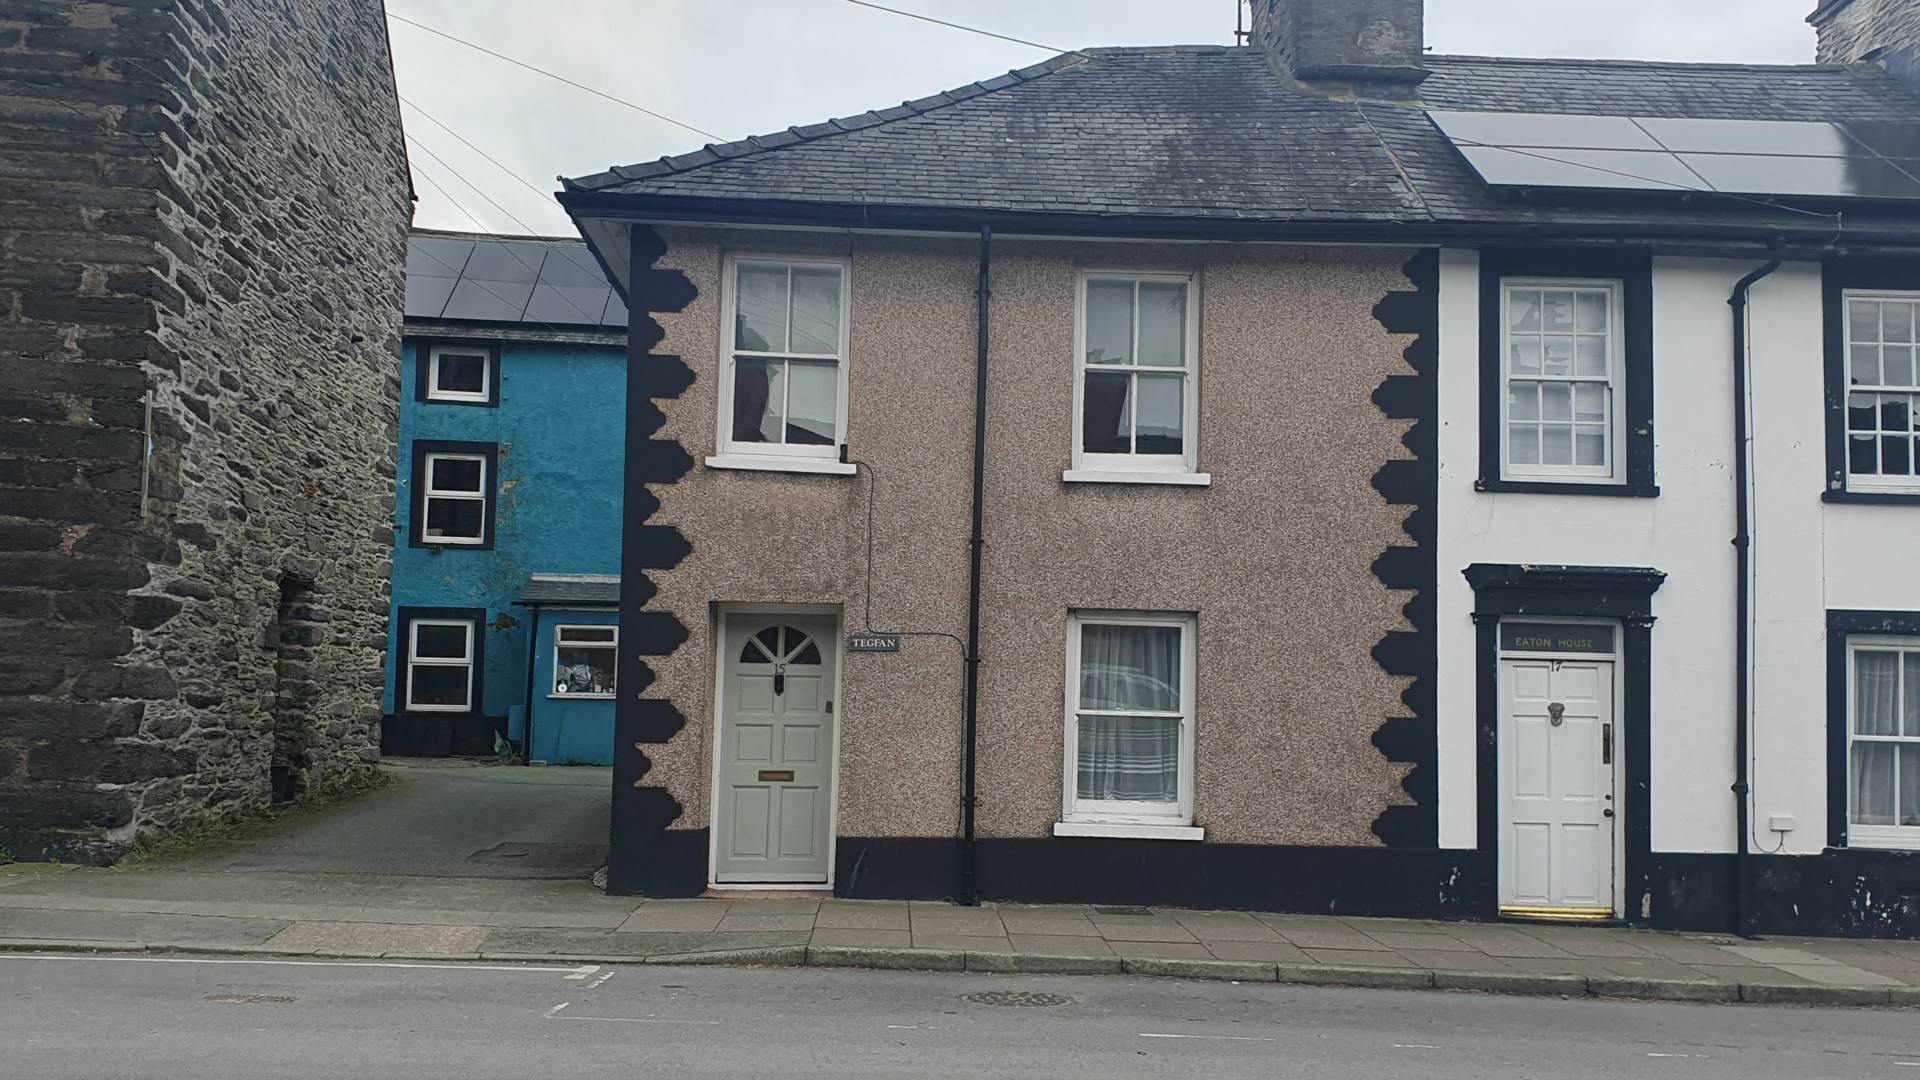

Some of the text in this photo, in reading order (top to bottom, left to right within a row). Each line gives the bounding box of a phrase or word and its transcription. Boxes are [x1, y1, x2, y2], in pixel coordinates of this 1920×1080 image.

[852, 638, 896, 648] TEGFAN
[1515, 637, 1593, 648] EATON HOUSE
[774, 663, 787, 675] 15
[1551, 661, 1562, 672] 17
